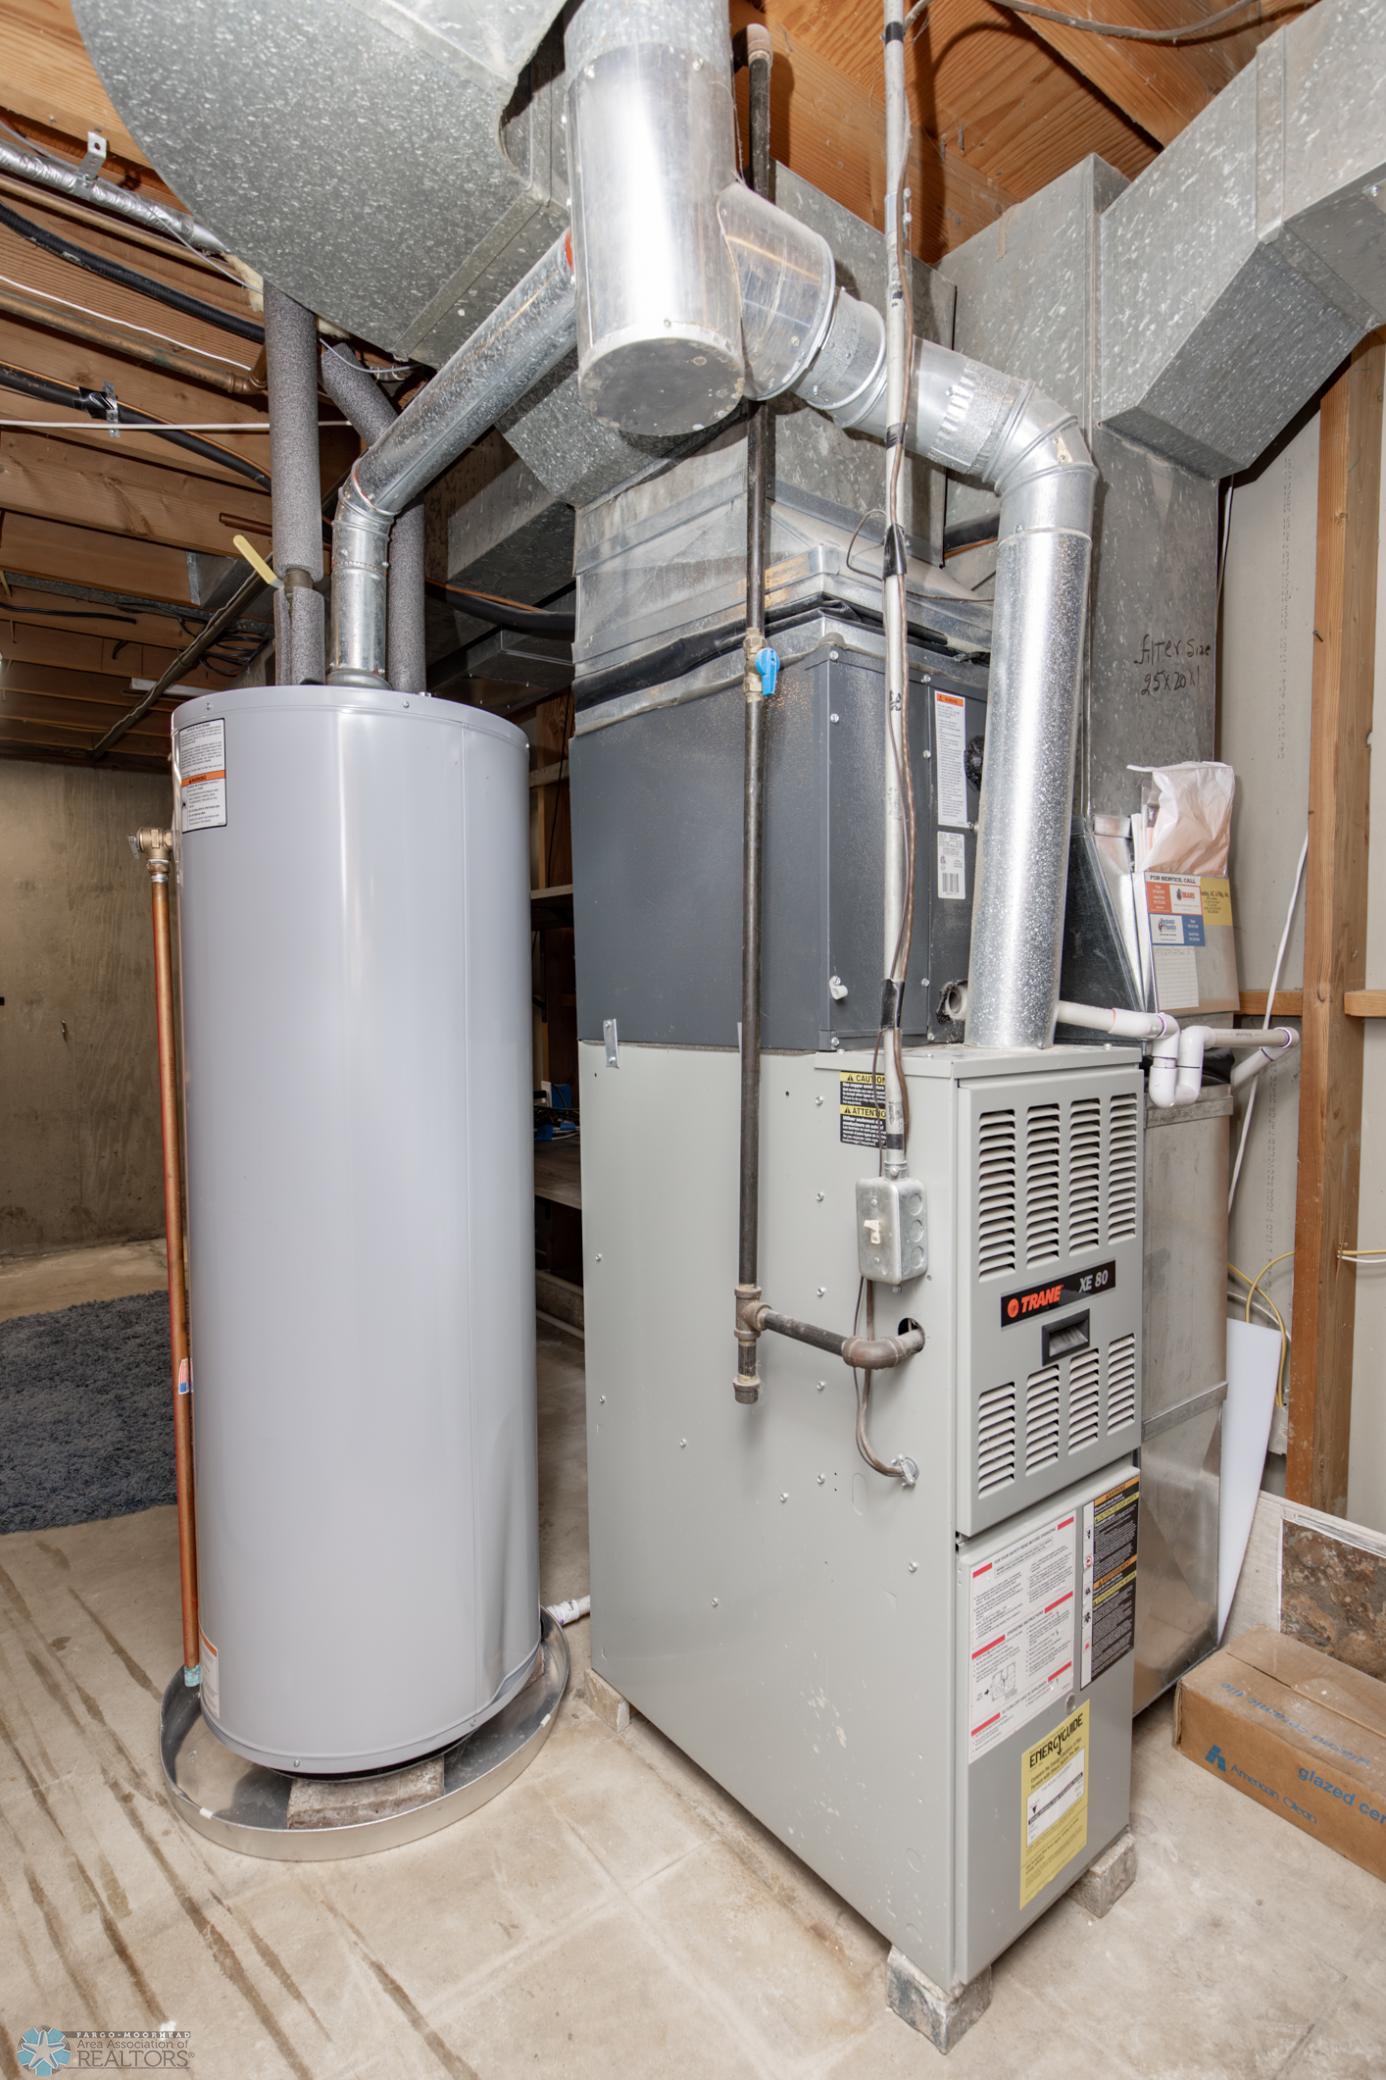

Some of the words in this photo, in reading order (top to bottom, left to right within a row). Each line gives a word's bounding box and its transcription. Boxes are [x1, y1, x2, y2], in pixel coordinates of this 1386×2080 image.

[1186, 638, 1211, 658] Size
[1078, 1275, 1093, 1293] XE
[1094, 1270, 1109, 1288] 80
[1020, 1284, 1064, 1313] TRANE
[1296, 1766, 1357, 1807] glazed
